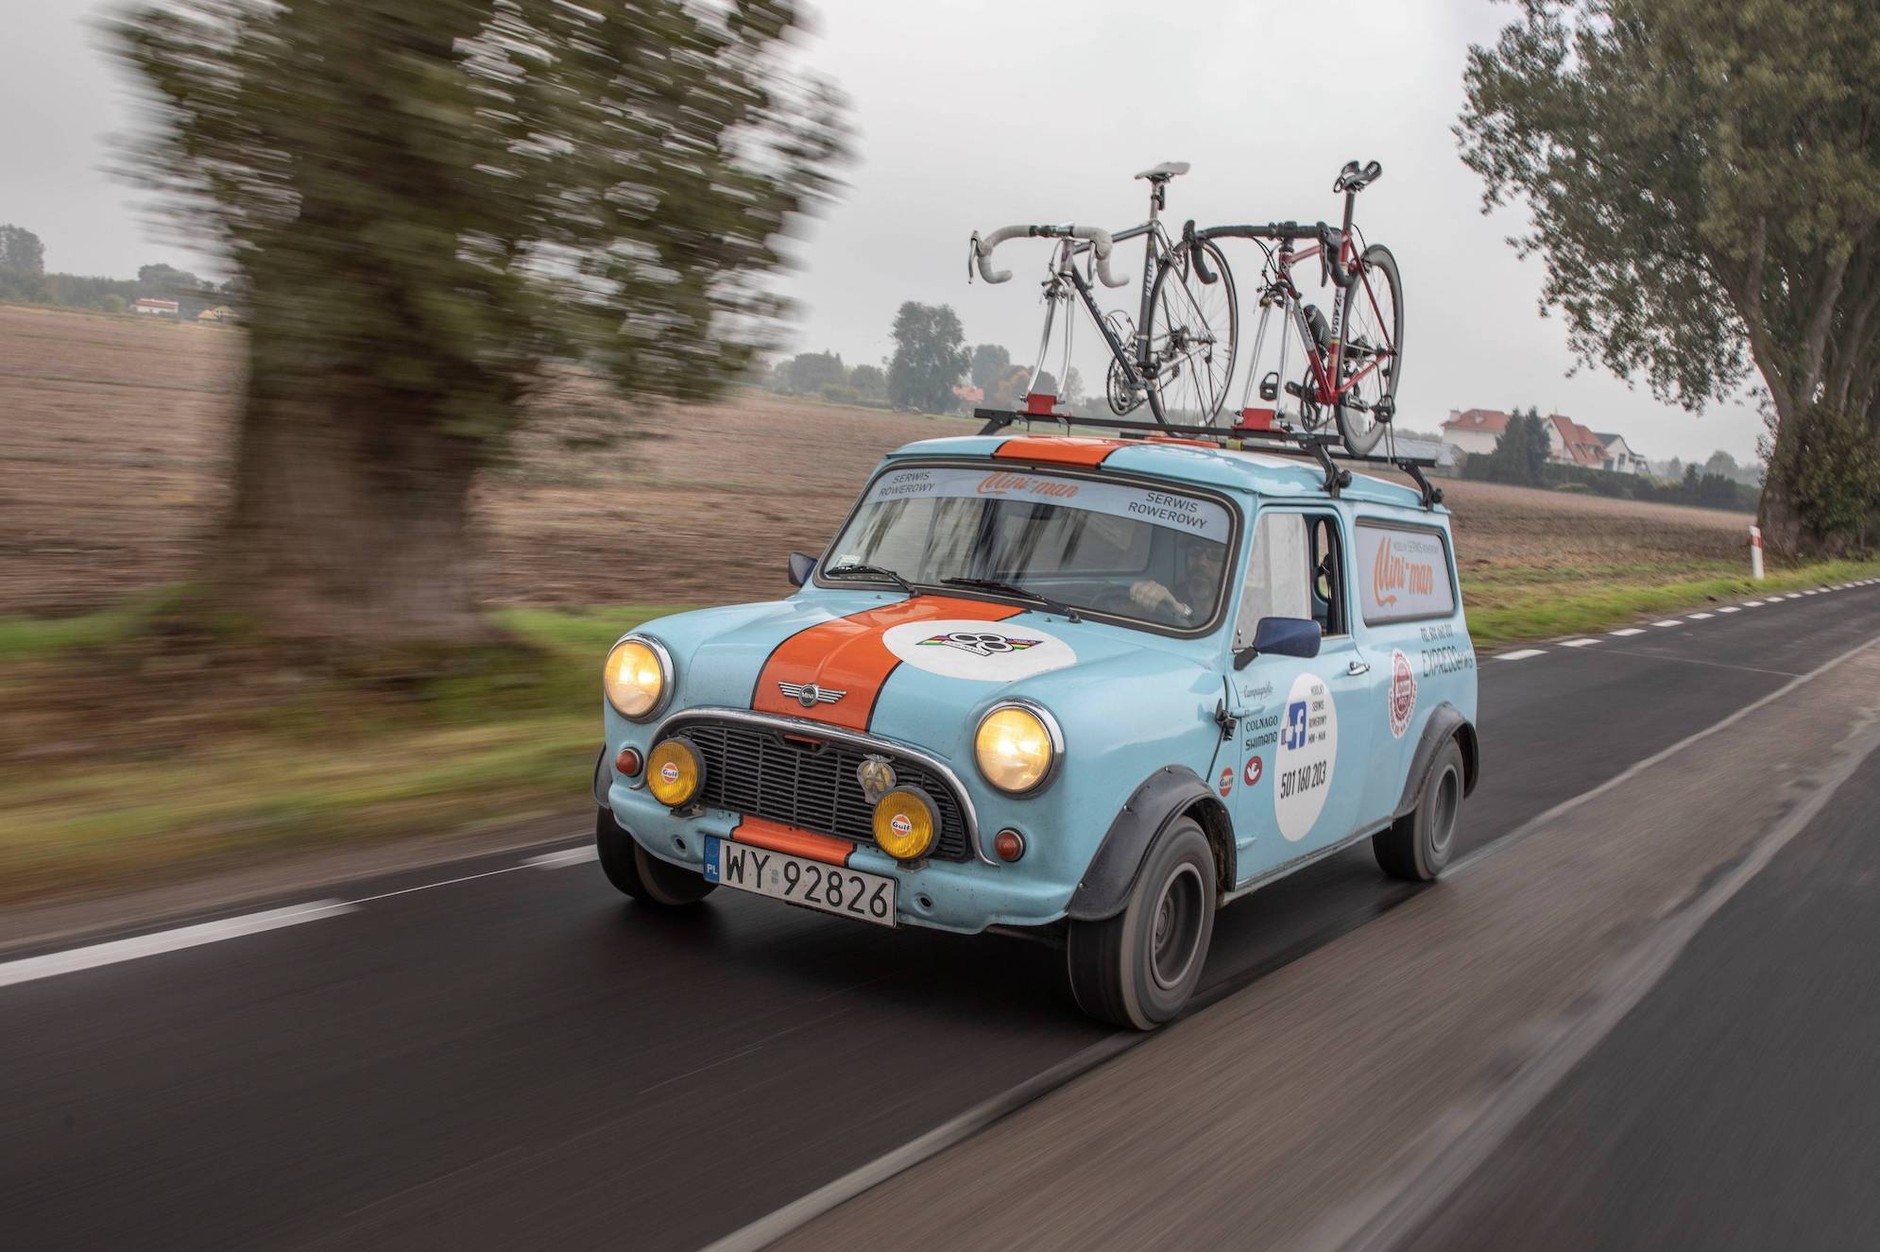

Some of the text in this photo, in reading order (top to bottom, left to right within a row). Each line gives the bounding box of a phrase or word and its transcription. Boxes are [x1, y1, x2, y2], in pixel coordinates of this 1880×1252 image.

[892, 471, 931, 484] SERWIS
[878, 482, 936, 497] ROWEROWY
[1146, 492, 1199, 513] SERWIS
[1128, 502, 1208, 529] ROWEROWY
[1245, 715, 1279, 733] COLNAGO
[1245, 731, 1278, 751] SHIMANO
[662, 769, 678, 778] Gulf
[1220, 777, 1233, 787] Gulf
[1280, 760, 1327, 799] 501 160 203
[892, 821, 910, 831] Gulf
[706, 845, 888, 918] PL WY 92826
